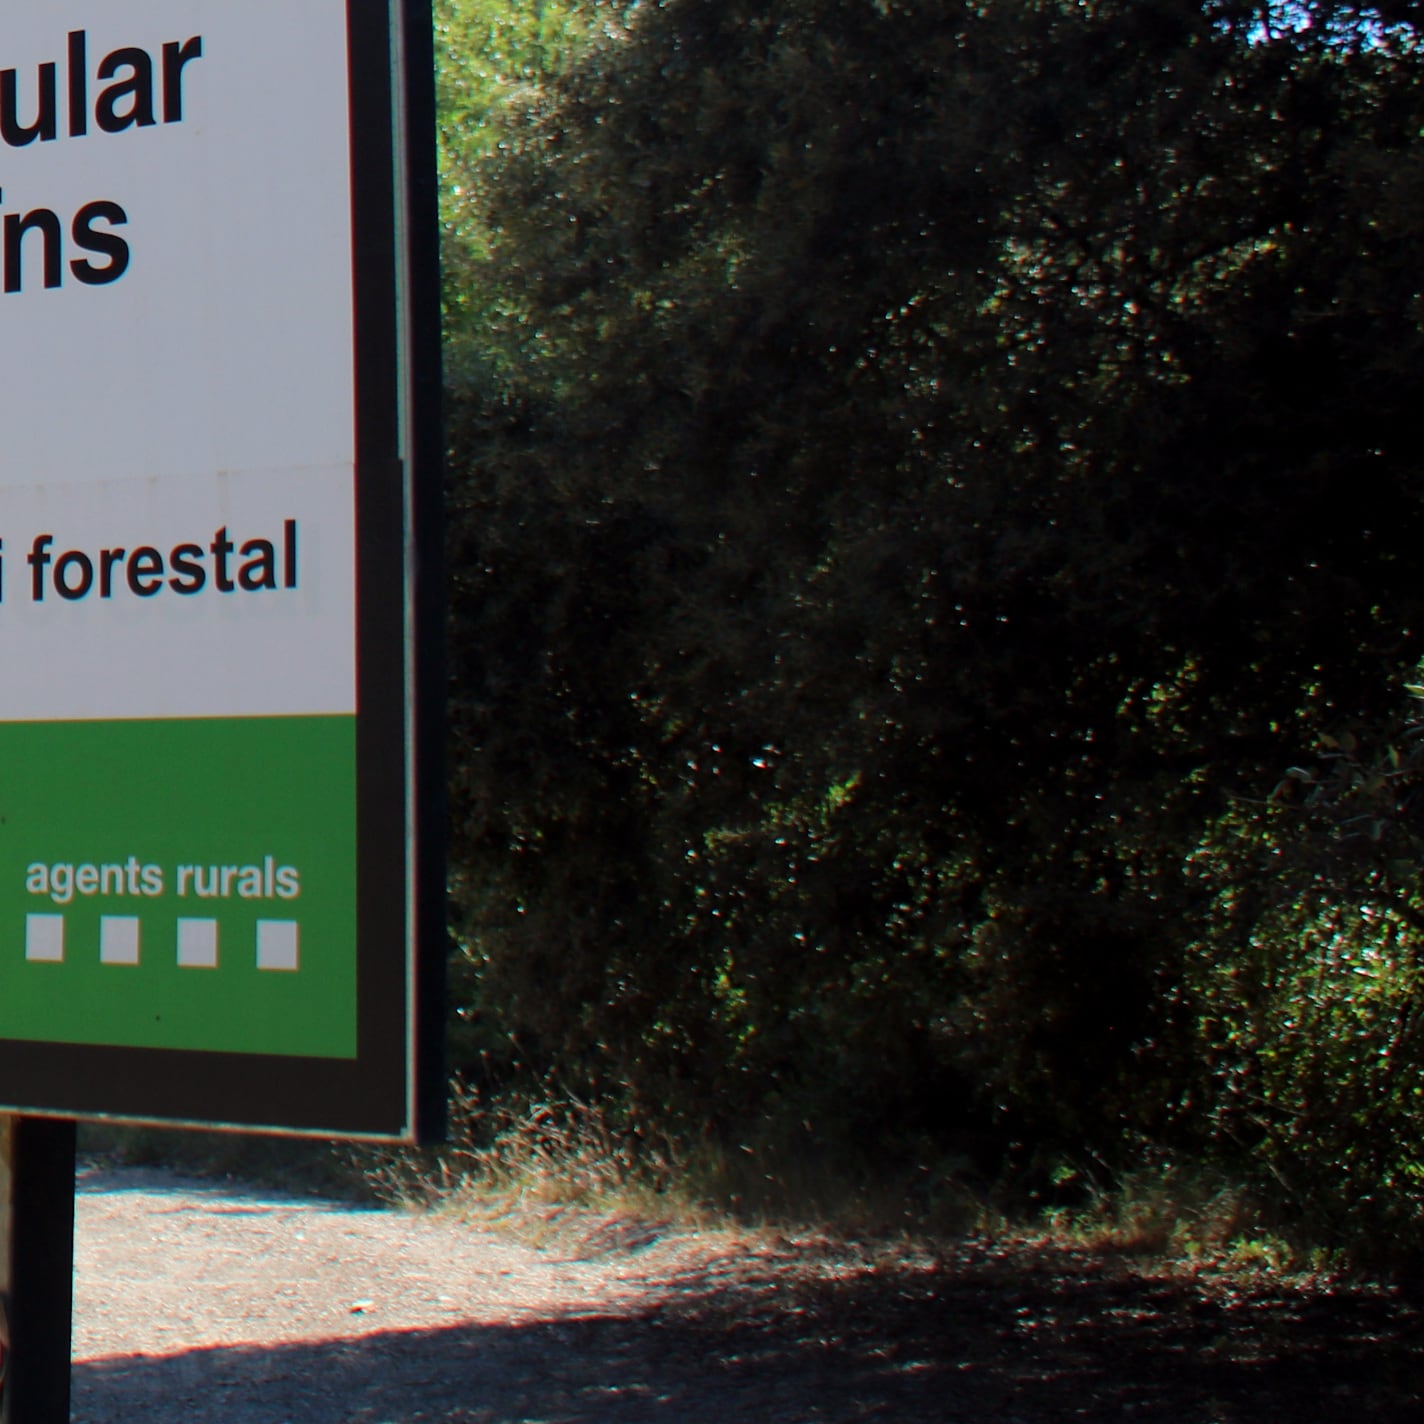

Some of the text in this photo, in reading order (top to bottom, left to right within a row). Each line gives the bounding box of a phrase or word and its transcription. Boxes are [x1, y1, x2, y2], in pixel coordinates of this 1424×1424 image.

[27, 519, 297, 602] forestal
[26, 855, 300, 904] agents rurals
